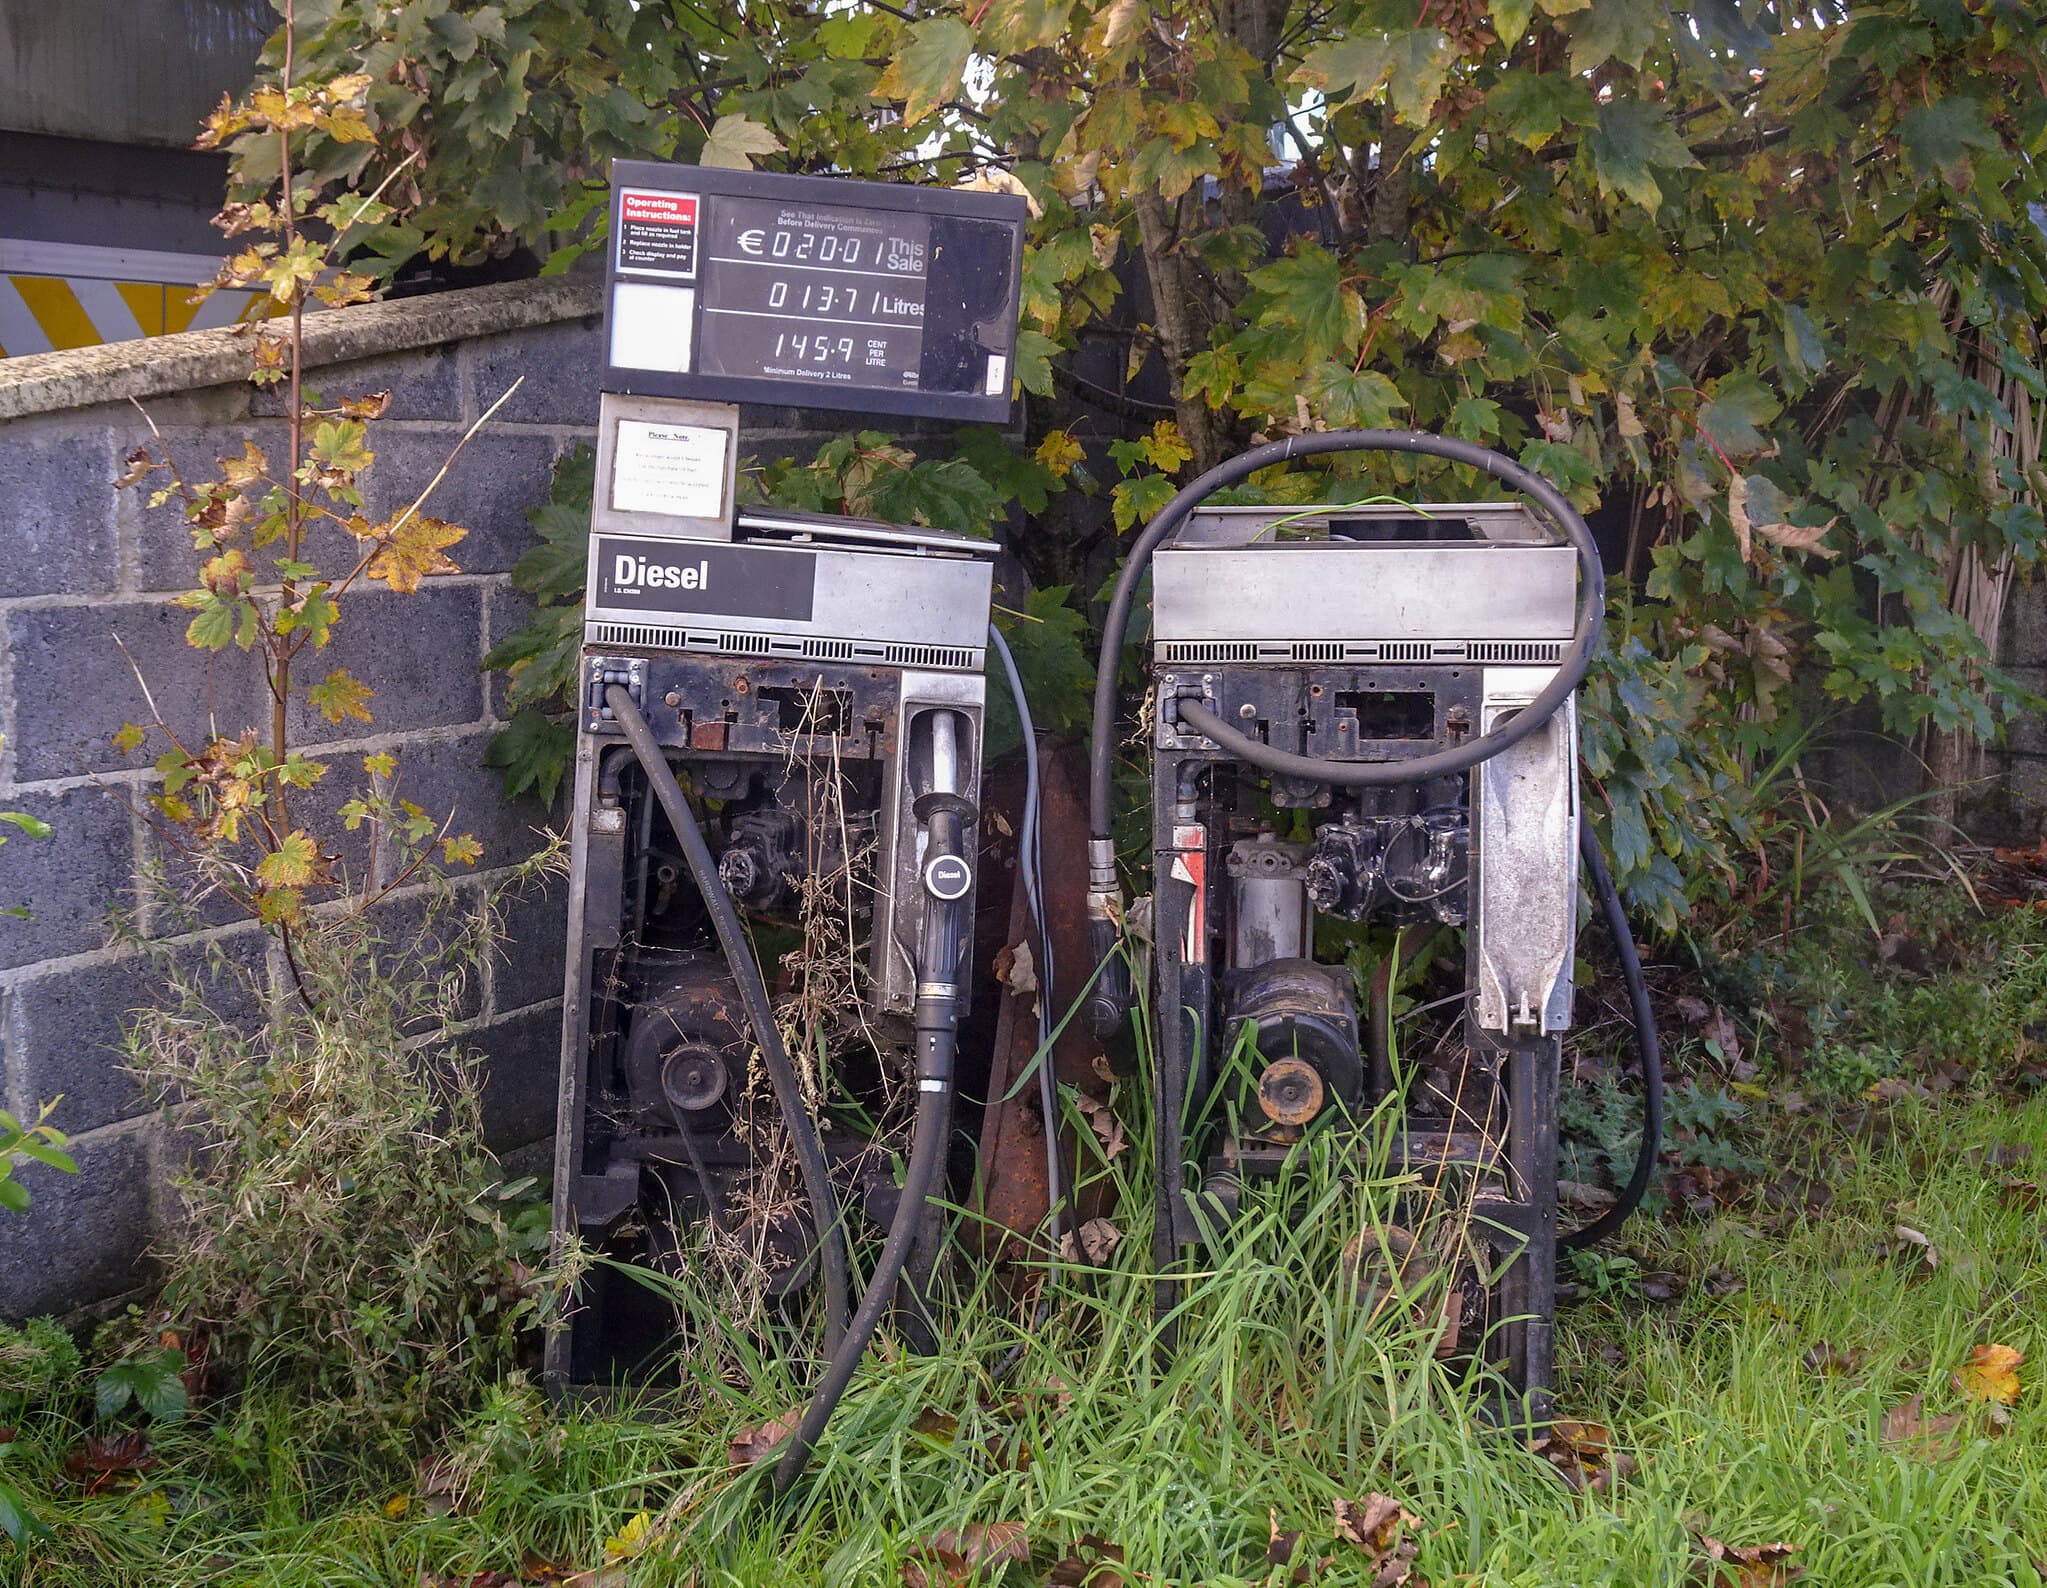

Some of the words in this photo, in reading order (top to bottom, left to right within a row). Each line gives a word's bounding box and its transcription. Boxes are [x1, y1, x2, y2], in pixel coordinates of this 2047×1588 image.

[627, 196, 677, 211] Operating
[627, 208, 691, 221] Instructions:
[780, 209, 796, 219] See
[798, 211, 815, 220] That
[778, 217, 803, 227] Before
[804, 220, 835, 232] Delivery
[888, 237, 924, 256] This
[887, 254, 924, 272] Sale
[882, 298, 925, 317] Litres
[868, 340, 888, 348] CENT
[869, 349, 884, 358] PER
[866, 358, 886, 366] LITRE
[764, 366, 795, 376] Minimum
[796, 368, 824, 379] Delivery
[832, 372, 852, 380] Litres
[648, 431, 668, 439] Please
[615, 555, 708, 590] Diesel
[938, 870, 960, 879] Diesel
[698, 869, 720, 912] HARDWALL
